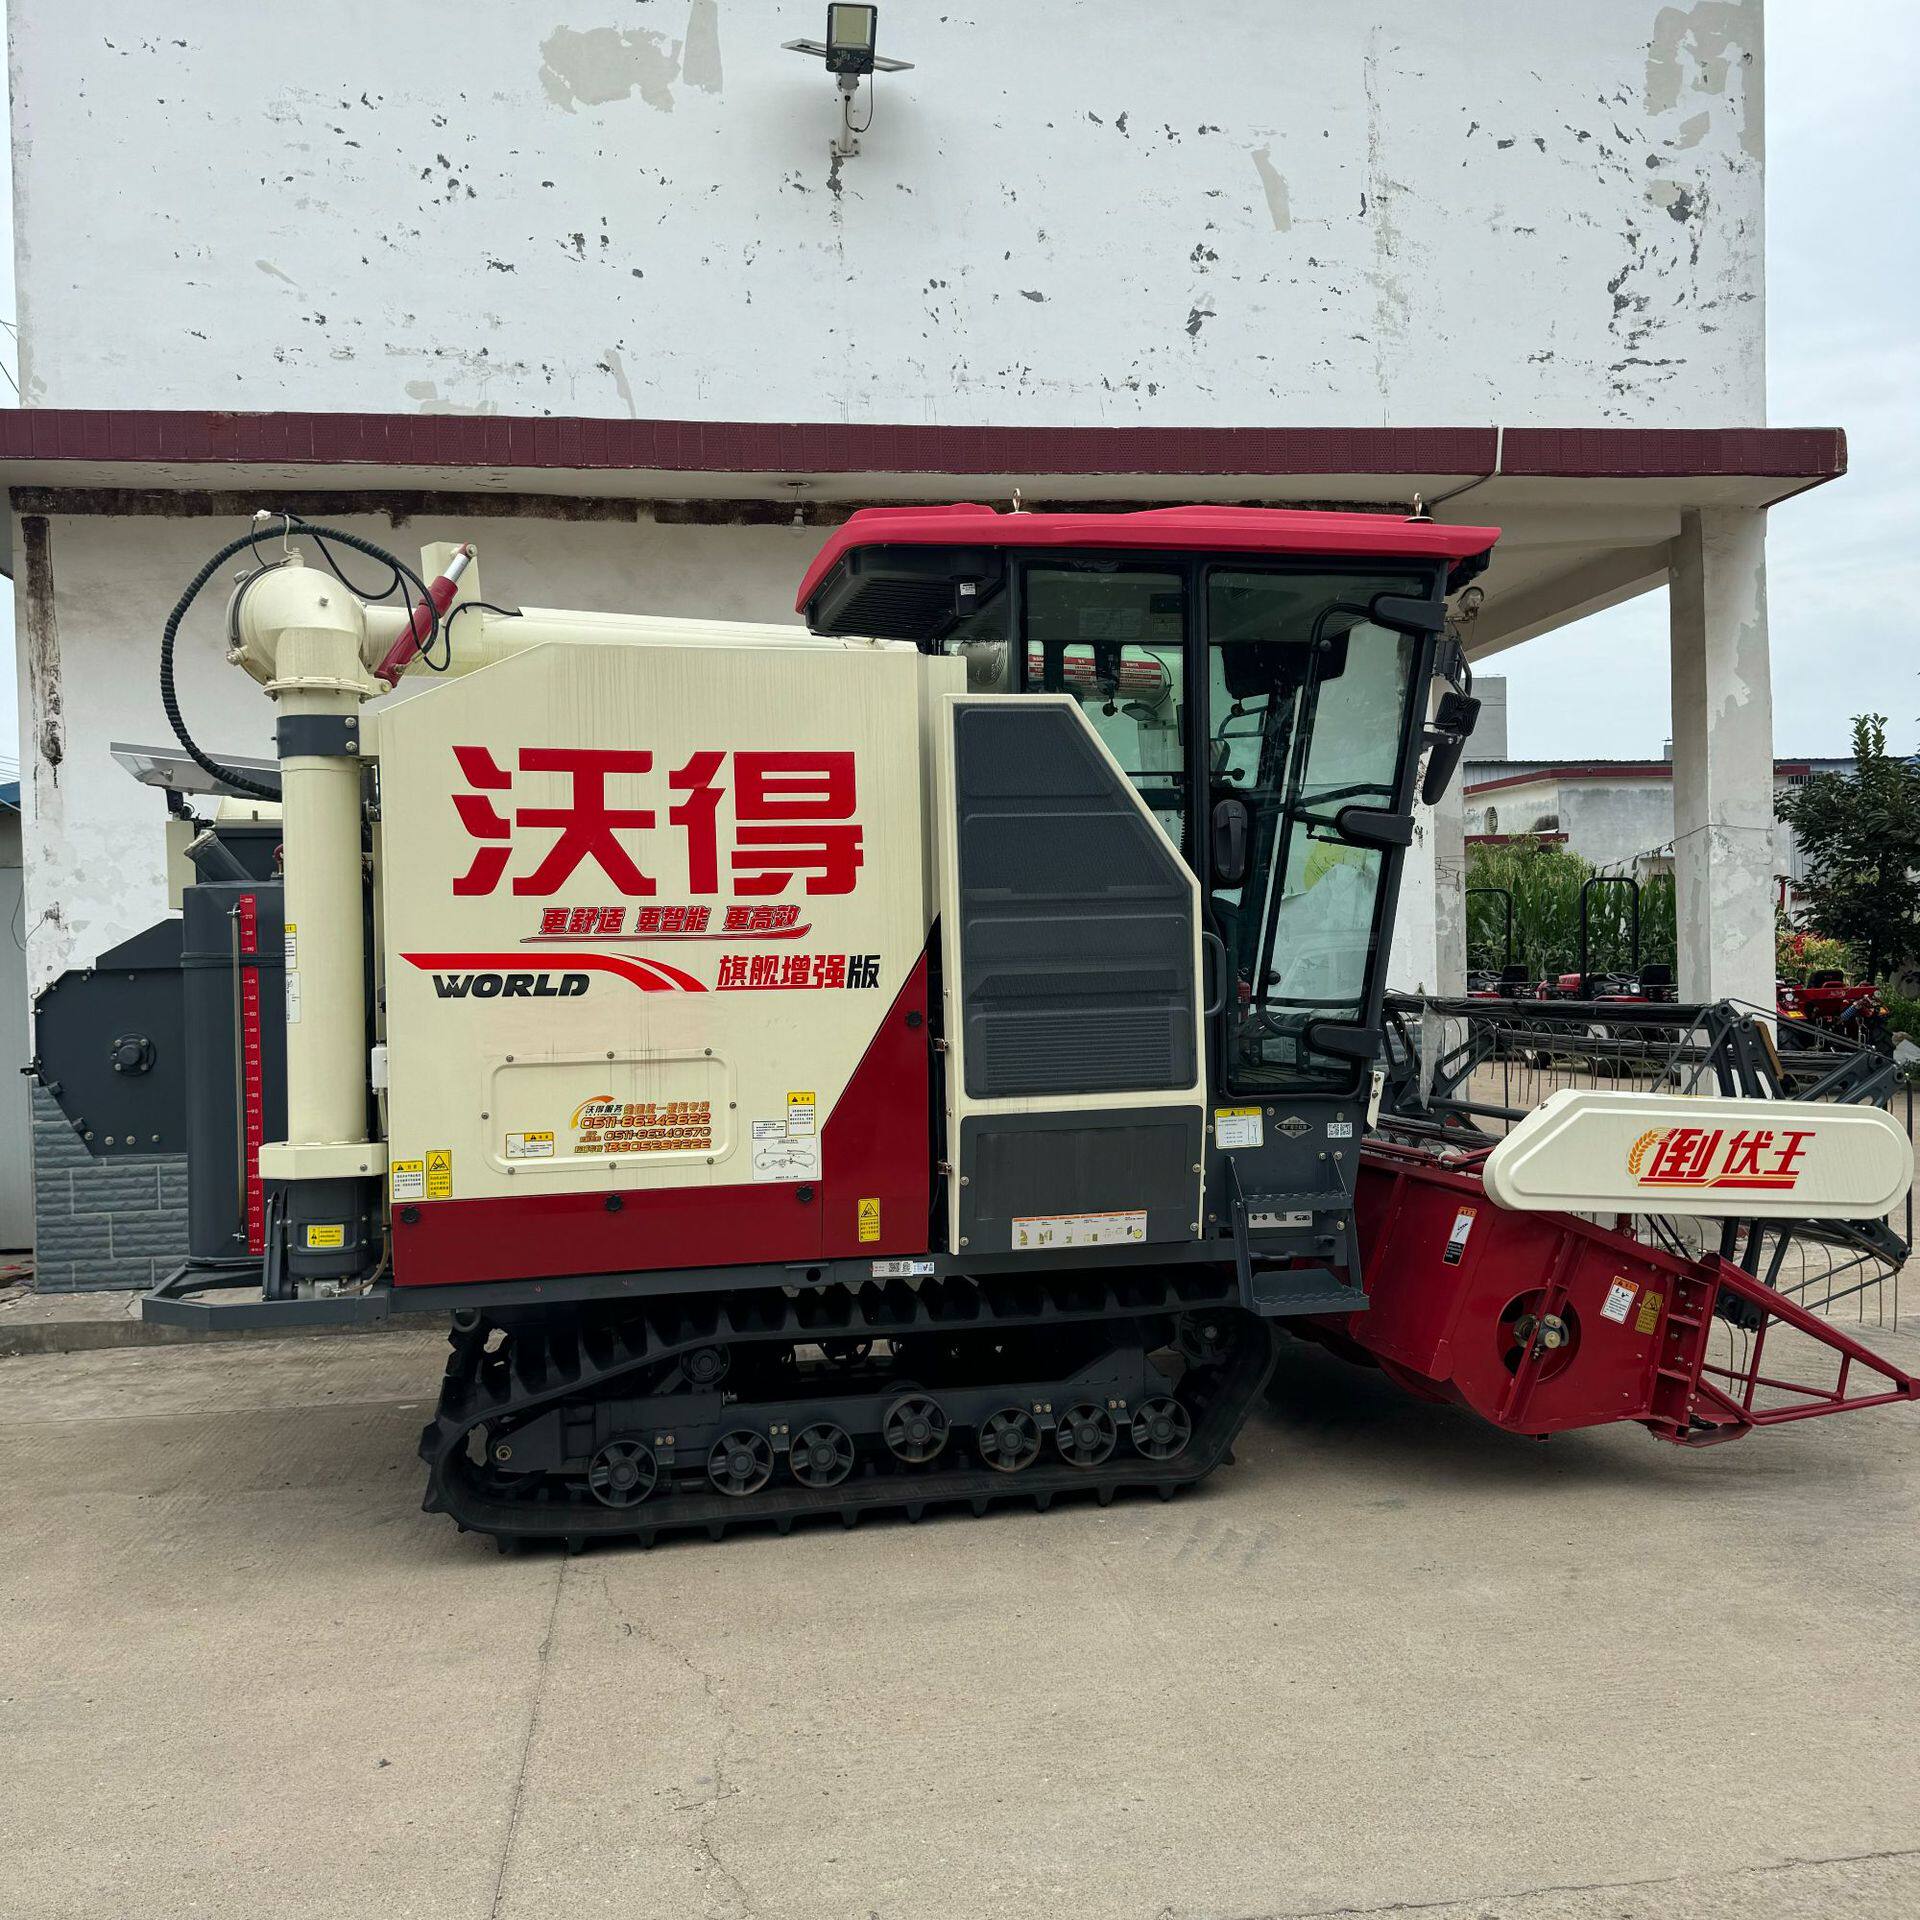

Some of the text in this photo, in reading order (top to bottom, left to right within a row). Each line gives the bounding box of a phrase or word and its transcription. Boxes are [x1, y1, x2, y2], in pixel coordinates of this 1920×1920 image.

[451, 745, 865, 897] 沃得
[538, 904, 802, 934] 更舒适 更智能 更高效
[432, 973, 590, 998] WORLD
[717, 954, 881, 991] 旗舰增强版
[580, 1113, 711, 1129] 0511-86342622
[604, 1127, 711, 1141] 0511-86340670
[604, 1139, 711, 1153] 13905292222
[1647, 1127, 1817, 1178] 倒伏王
